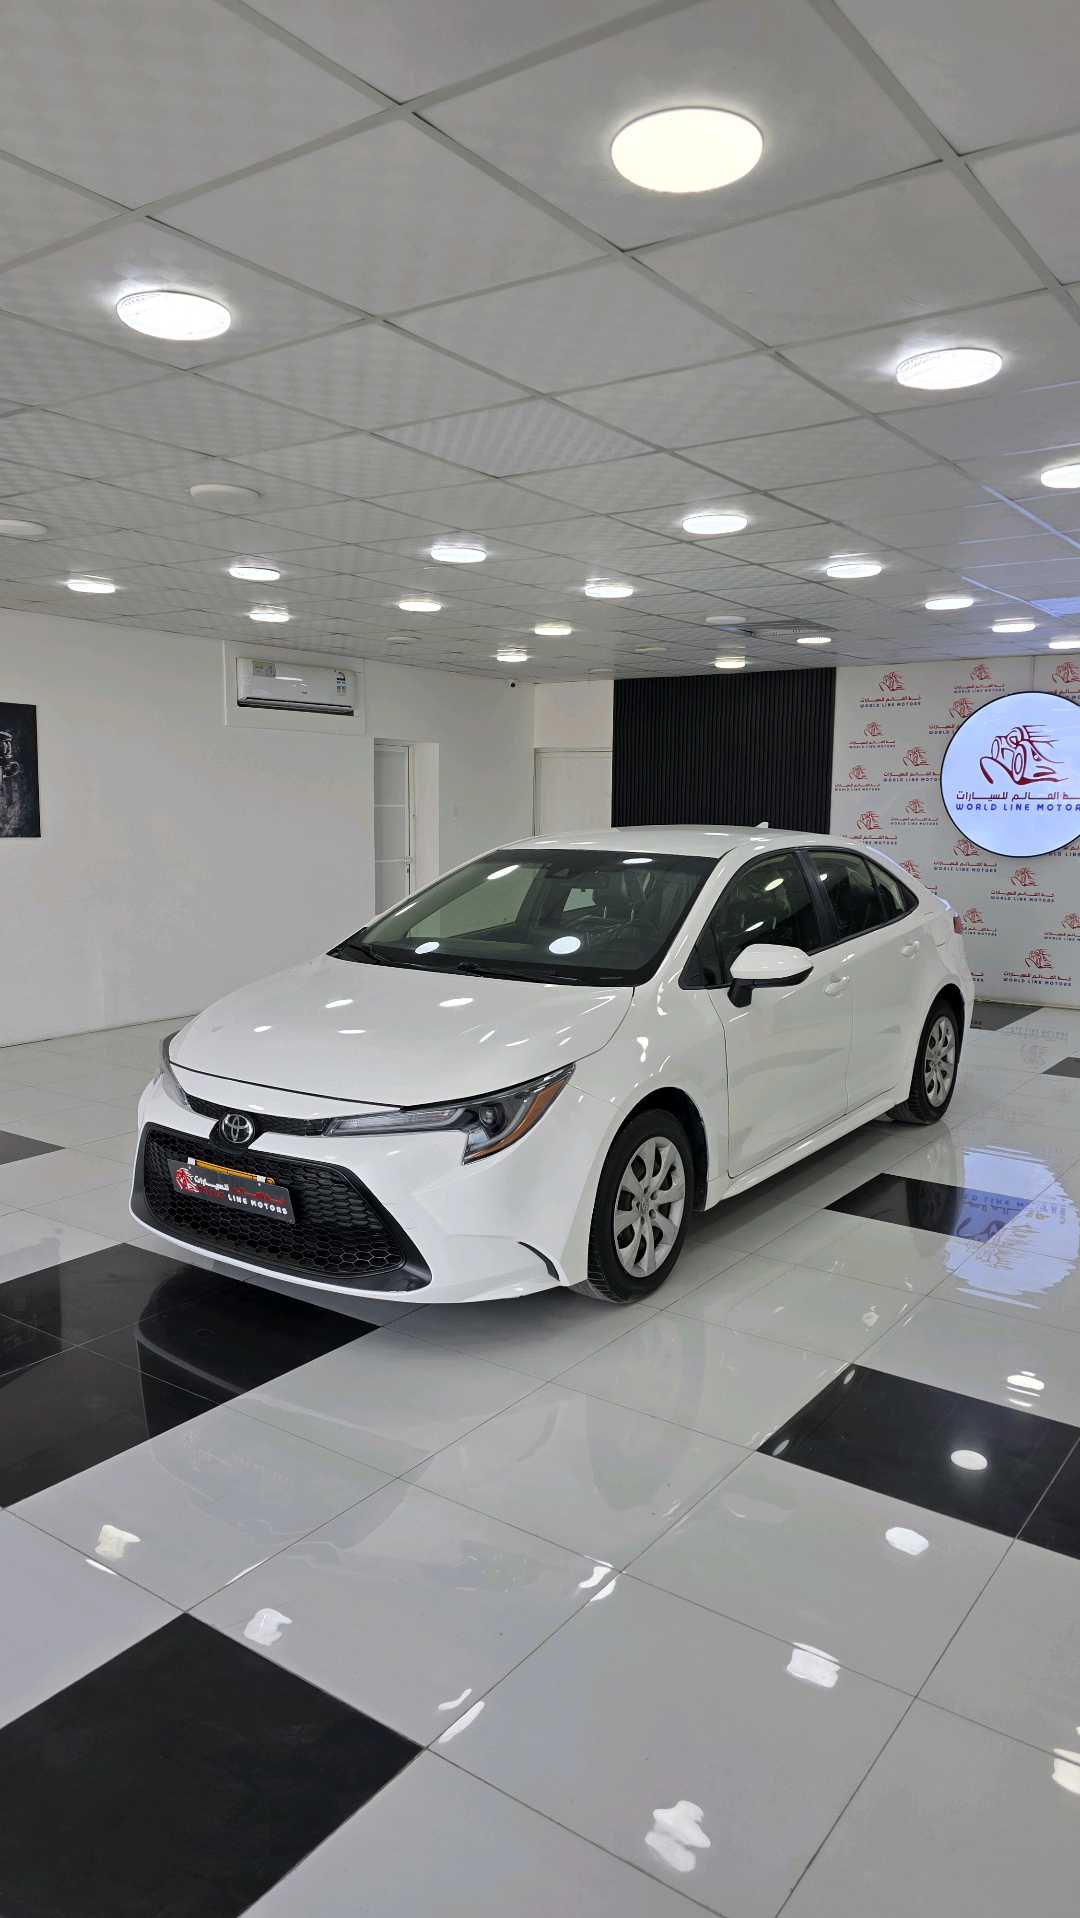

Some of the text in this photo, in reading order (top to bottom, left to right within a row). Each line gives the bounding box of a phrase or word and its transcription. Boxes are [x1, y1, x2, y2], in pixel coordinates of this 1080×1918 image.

[956, 790, 1008, 802] للسيارات
[1012, 791, 1060, 802] العالم
[956, 803, 1080, 812] WORLD LINE MOTOR
[227, 1193, 249, 1205] LINE
[250, 1199, 288, 1215] MOTORS
